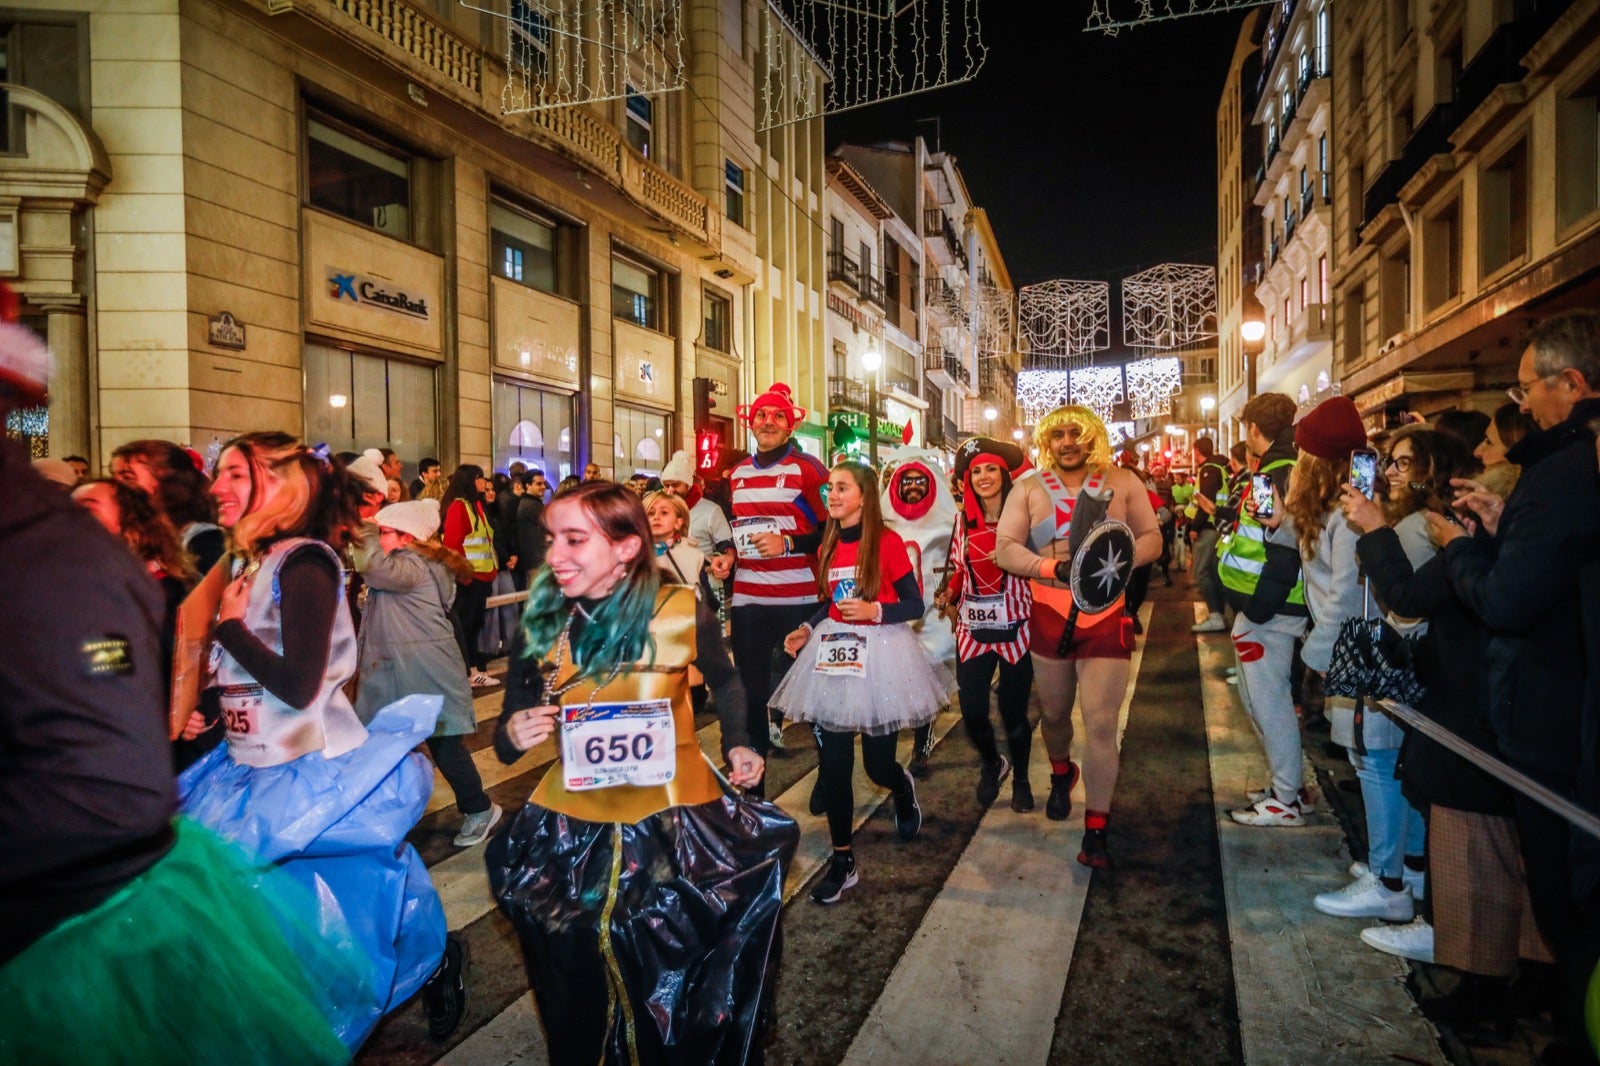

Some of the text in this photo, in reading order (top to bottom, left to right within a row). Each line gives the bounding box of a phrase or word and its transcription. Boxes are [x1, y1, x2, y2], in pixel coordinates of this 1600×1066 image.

[361, 281, 428, 316] CaixaBank
[863, 414, 904, 438] FRMAC
[968, 608, 997, 621] 884
[828, 647, 858, 662] 363
[585, 733, 654, 764] 650
